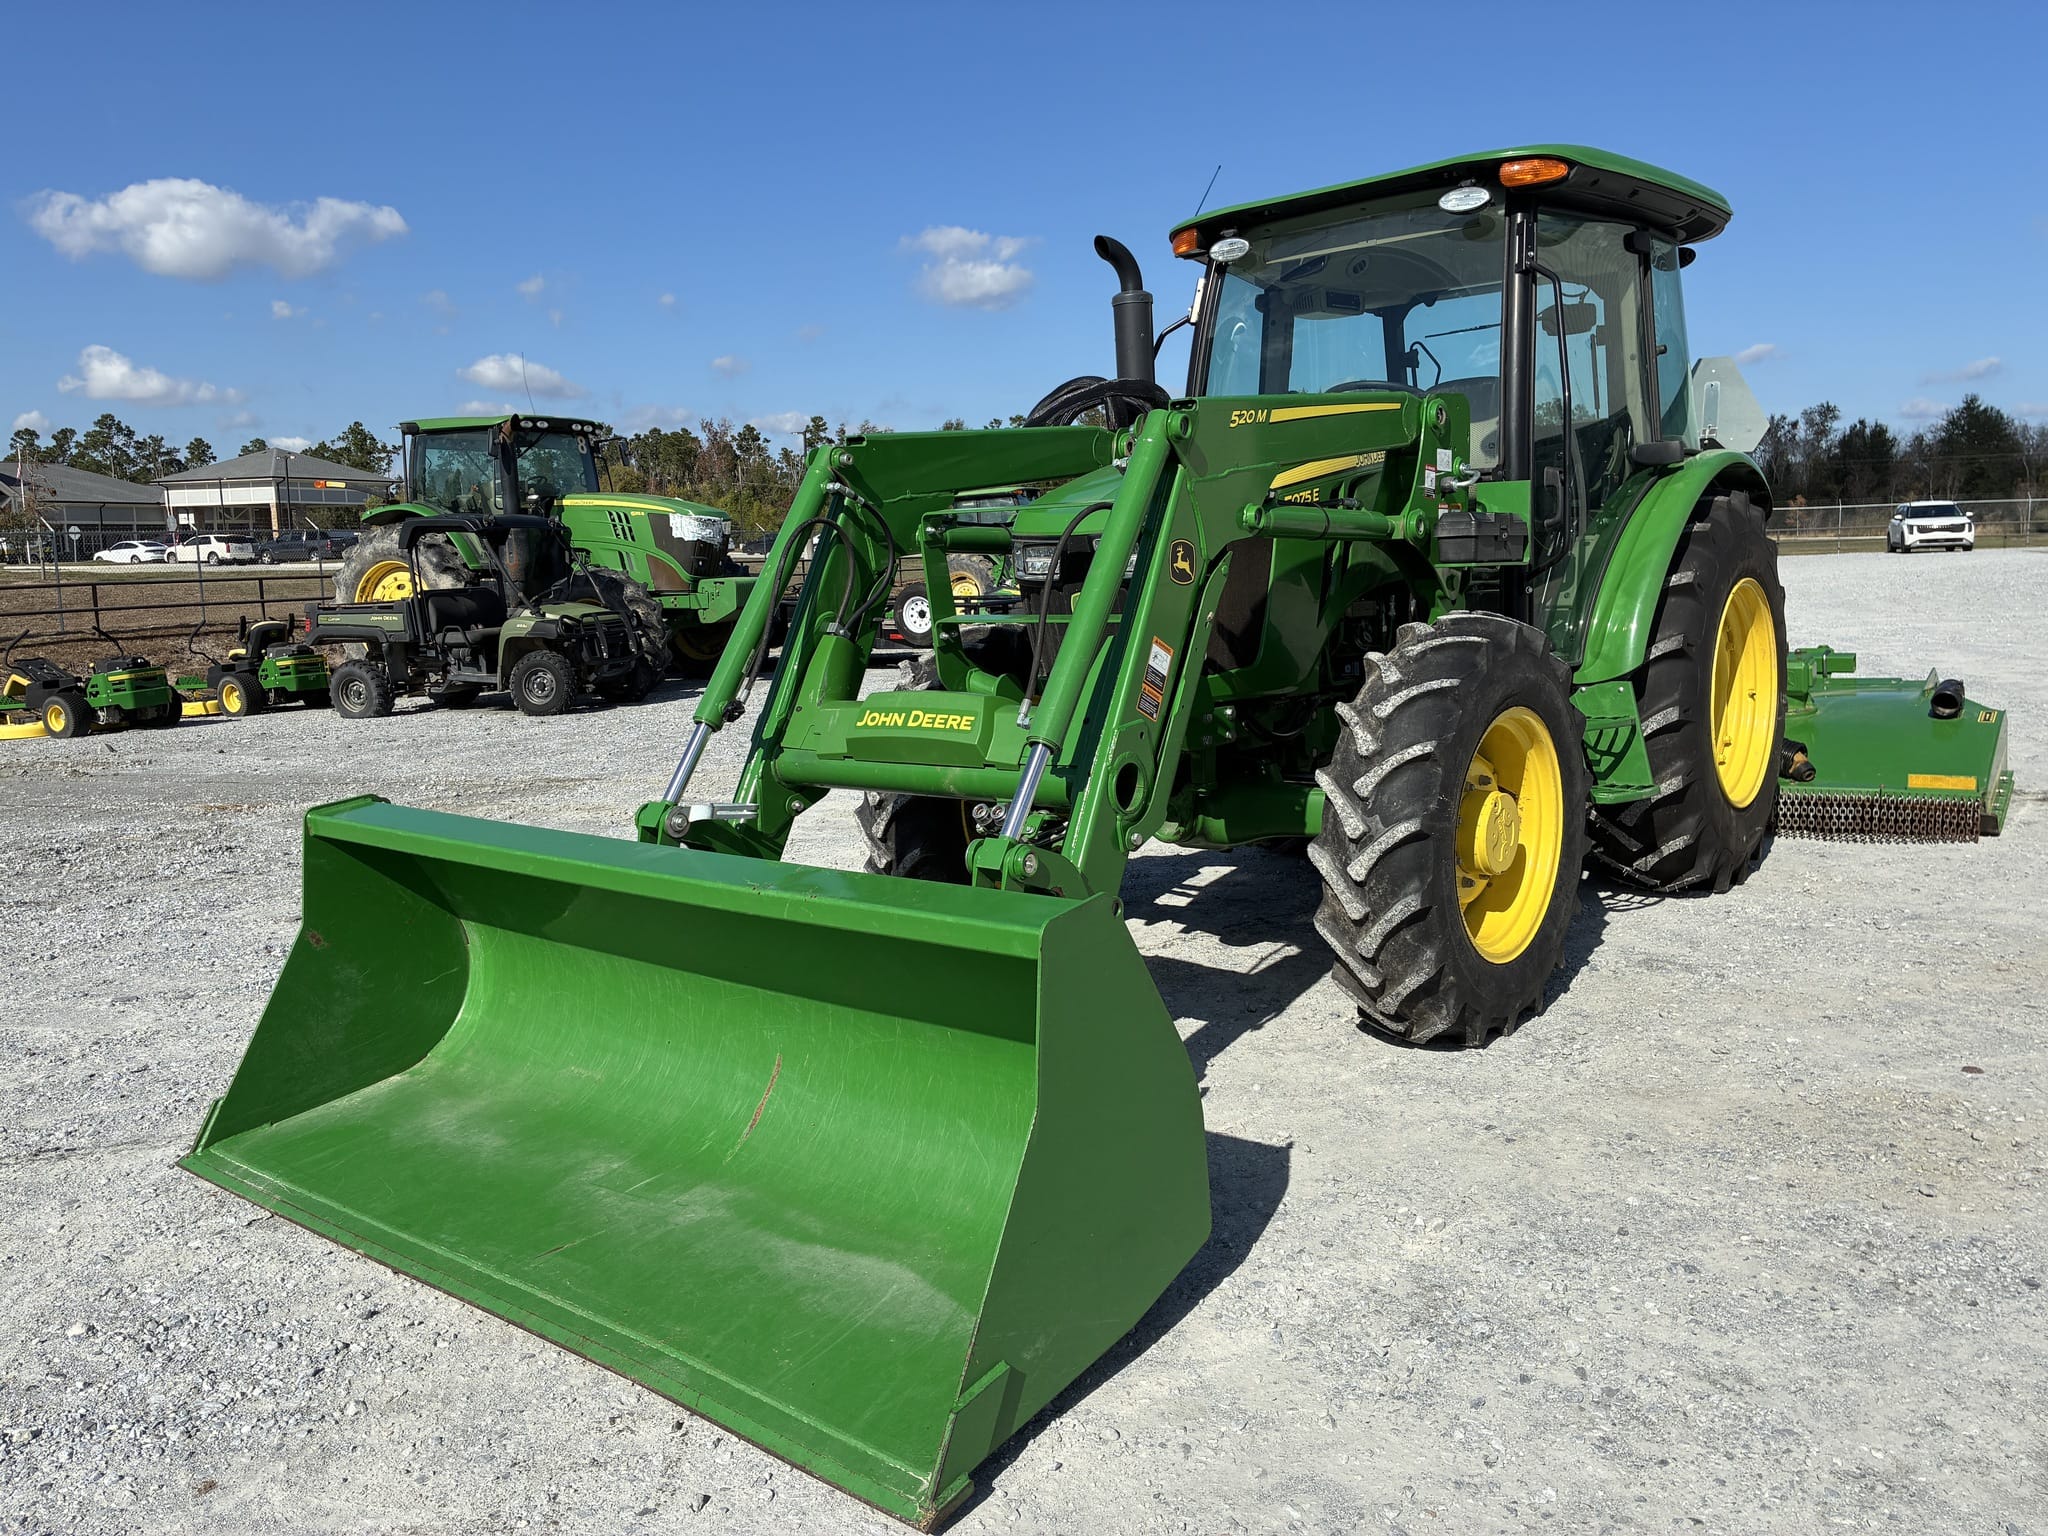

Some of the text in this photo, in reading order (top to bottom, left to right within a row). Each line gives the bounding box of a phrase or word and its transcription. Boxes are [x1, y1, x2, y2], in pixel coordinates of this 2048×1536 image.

[576, 435, 587, 454] 8
[856, 709, 975, 731] JOHN DEERE
